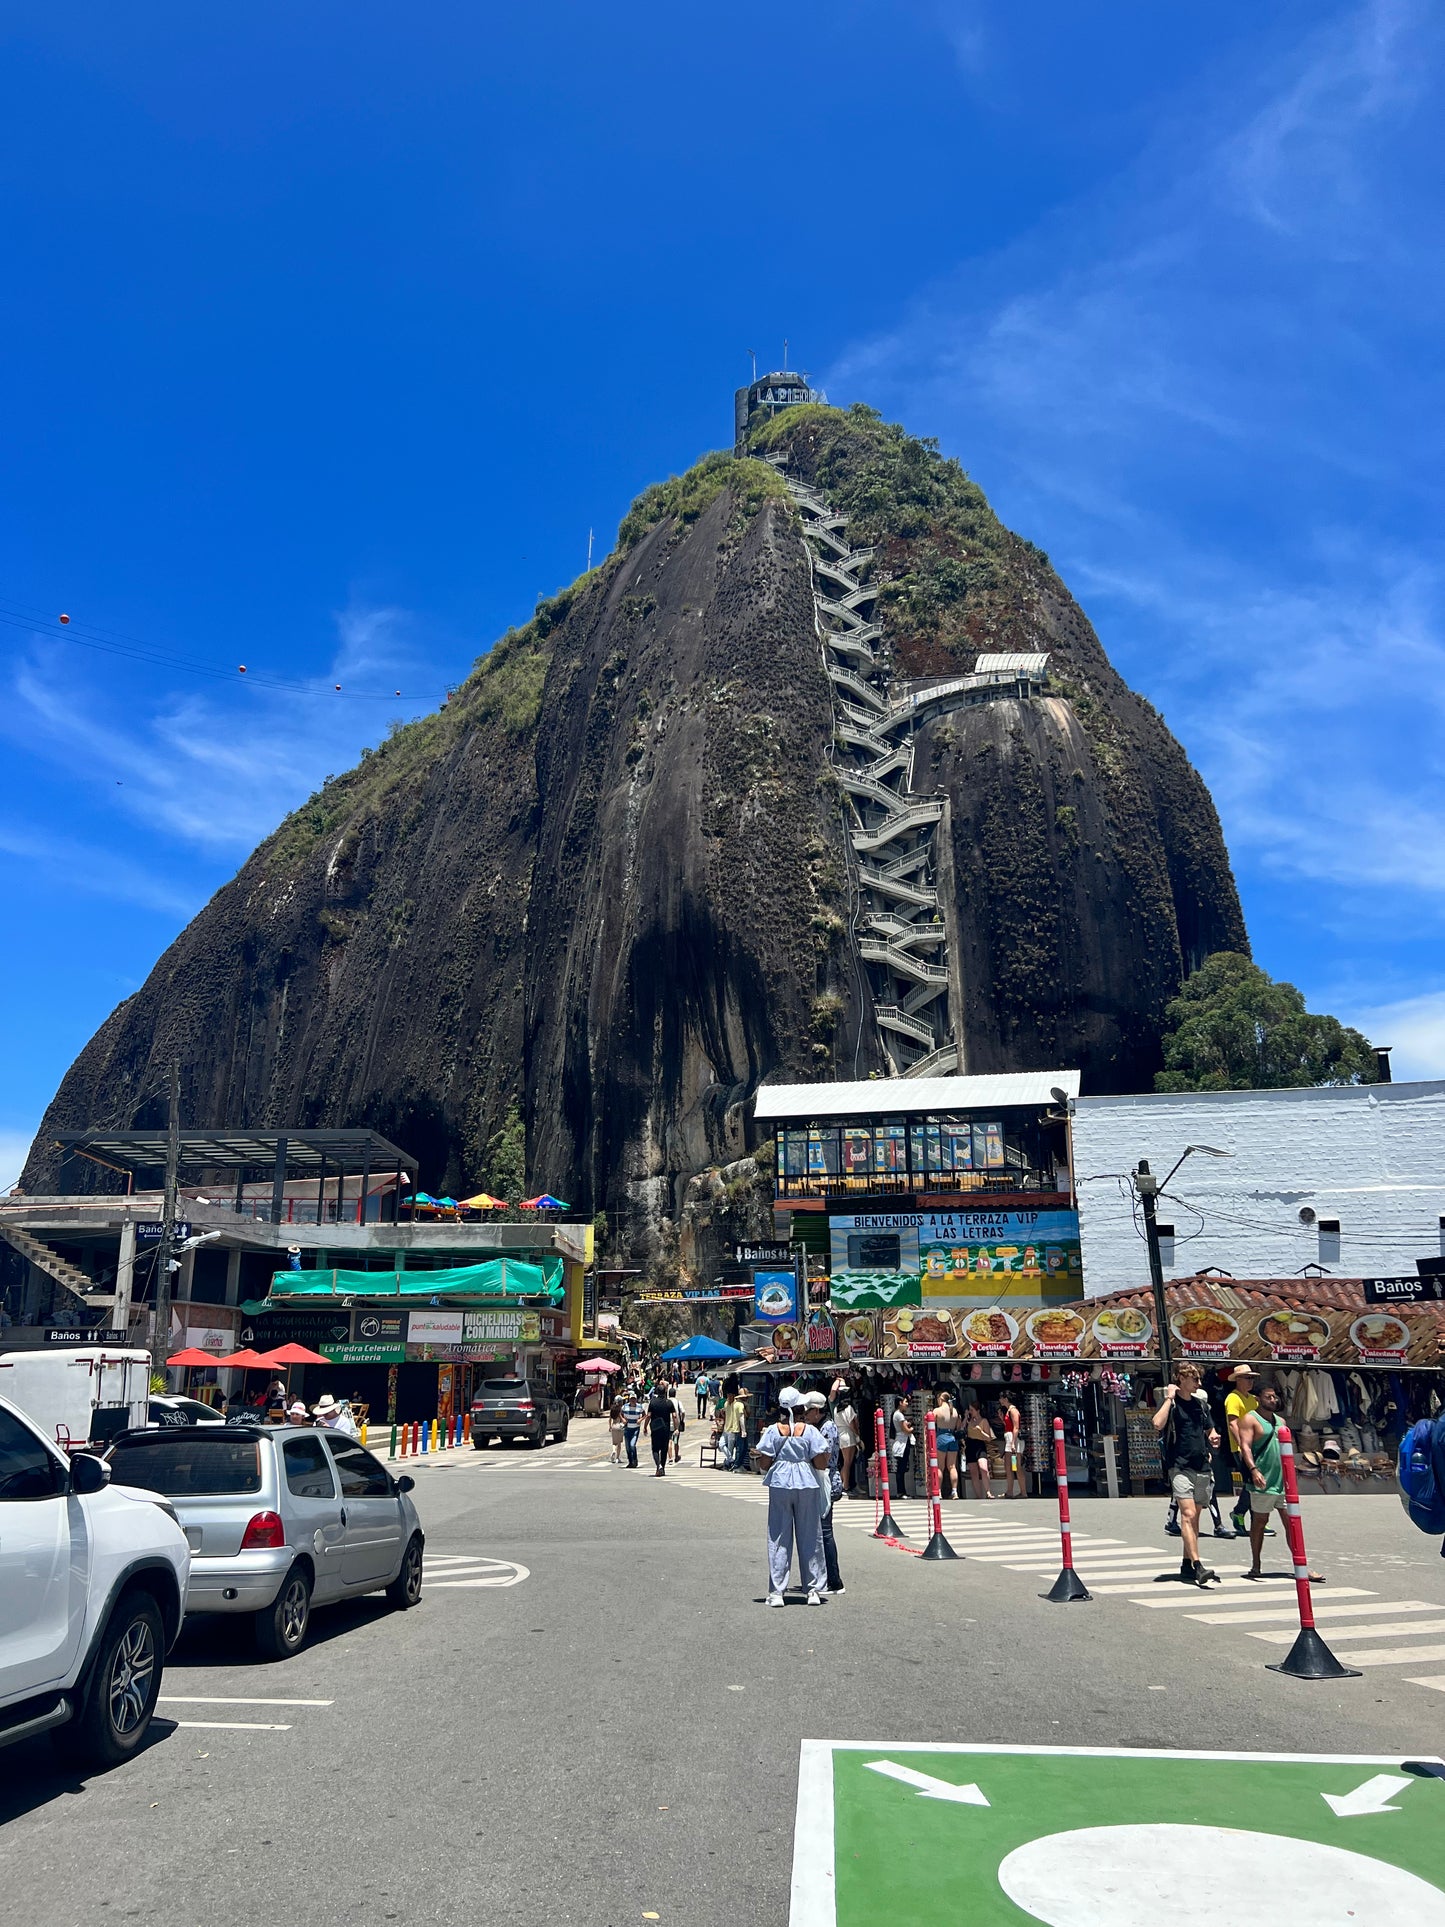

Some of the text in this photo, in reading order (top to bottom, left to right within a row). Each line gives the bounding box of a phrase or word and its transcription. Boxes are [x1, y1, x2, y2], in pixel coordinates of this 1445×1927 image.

[756, 387, 775, 403] LA
[854, 1212, 1038, 1227] BIENVENIDOS A LA TERRAZA VIP
[935, 1227, 1004, 1239] LAS LETRAS
[743, 1246, 777, 1260] Baños
[1374, 1279, 1423, 1294] Baños
[639, 1291, 684, 1301] TERRAZA
[684, 1290, 700, 1299] VIP
[701, 1289, 720, 1297] LAS
[464, 1313, 523, 1327] MICHELADAS
[50, 1331, 81, 1341] Baños
[466, 1325, 519, 1339] CON MANGO
[324, 1344, 401, 1354] La Piedra Celestial
[442, 1342, 497, 1353] Aromática
[976, 1343, 1006, 1351] Costilla
[1039, 1342, 1074, 1352] Bandeja
[1190, 1342, 1224, 1351] Pechuga
[1276, 1345, 1314, 1354] Bandeja
